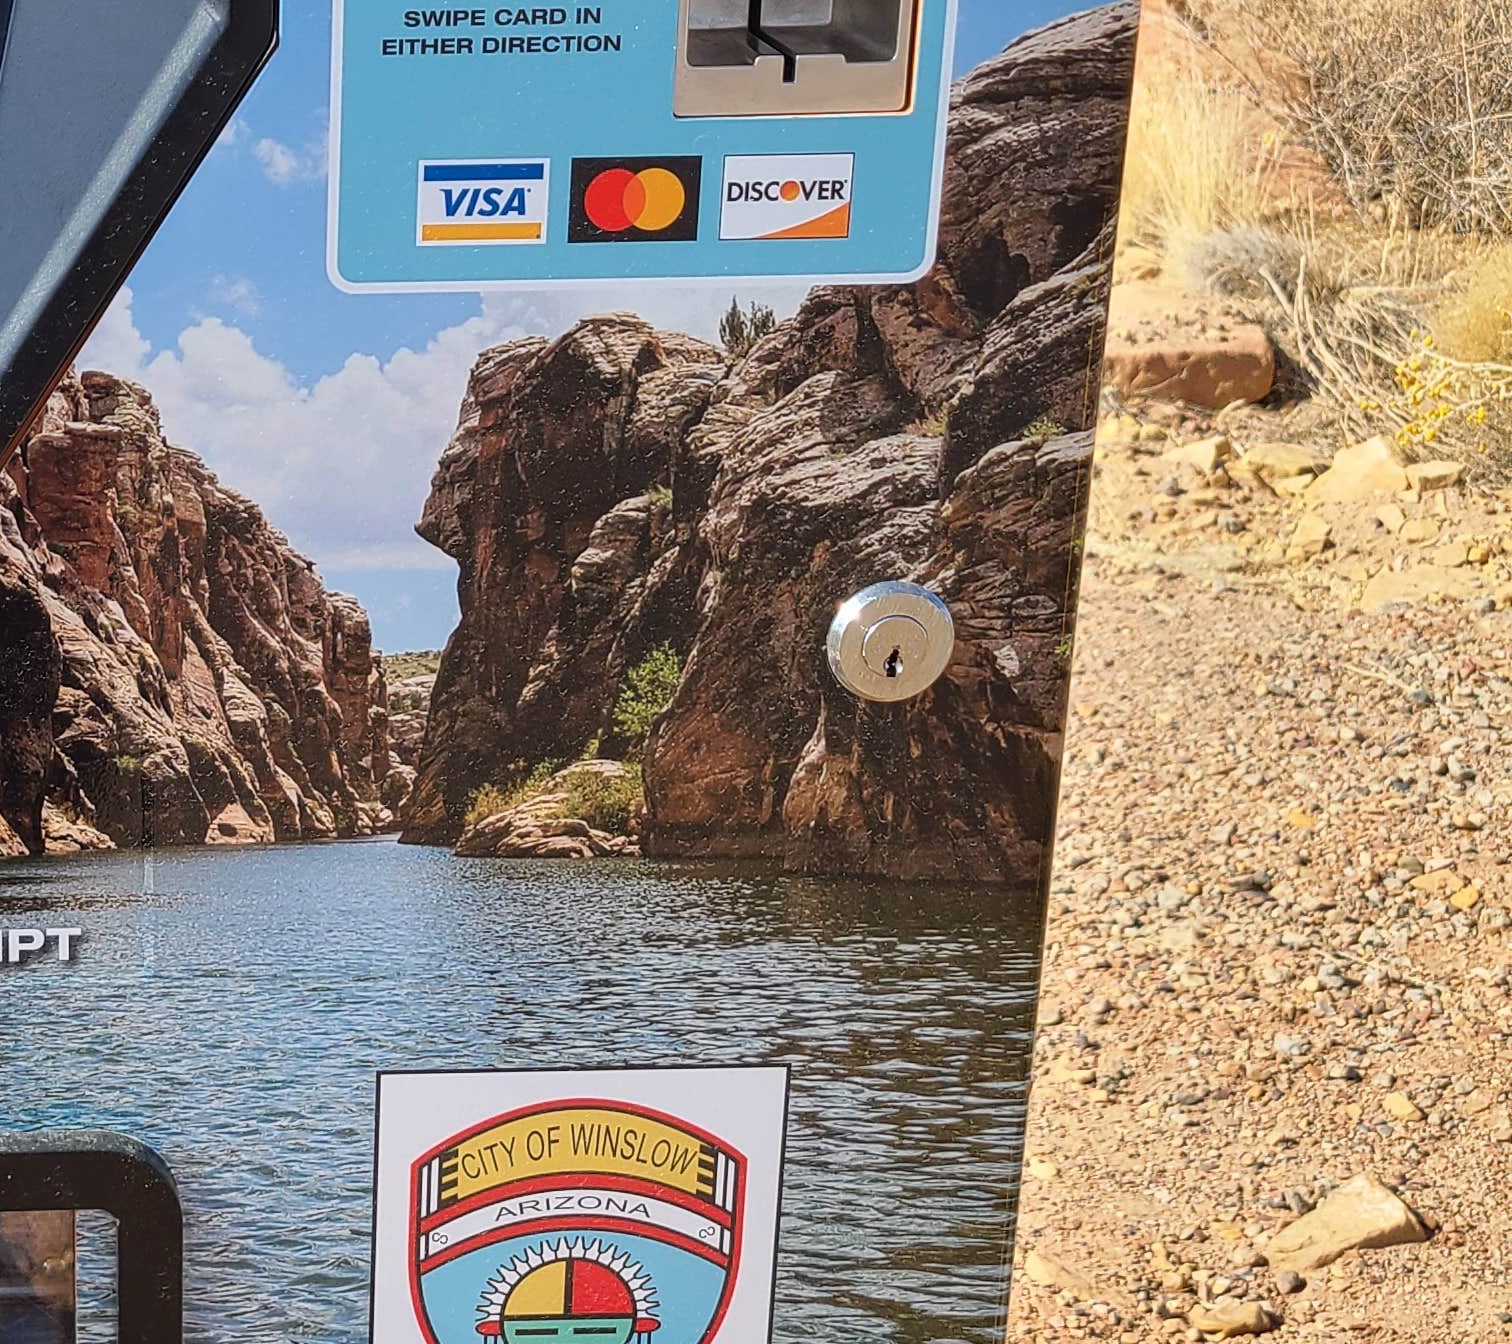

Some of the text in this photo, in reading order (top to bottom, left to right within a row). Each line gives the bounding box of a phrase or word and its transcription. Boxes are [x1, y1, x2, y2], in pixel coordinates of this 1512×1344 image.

[403, 7, 601, 27] SWIPE CARD IN
[381, 35, 621, 56] EITHER DIRECTION
[440, 187, 532, 217] VISA
[725, 179, 849, 202] DISCOVER
[461, 1123, 700, 1179] CITY OF WINSLOW
[494, 1196, 651, 1222] ARIZONA
